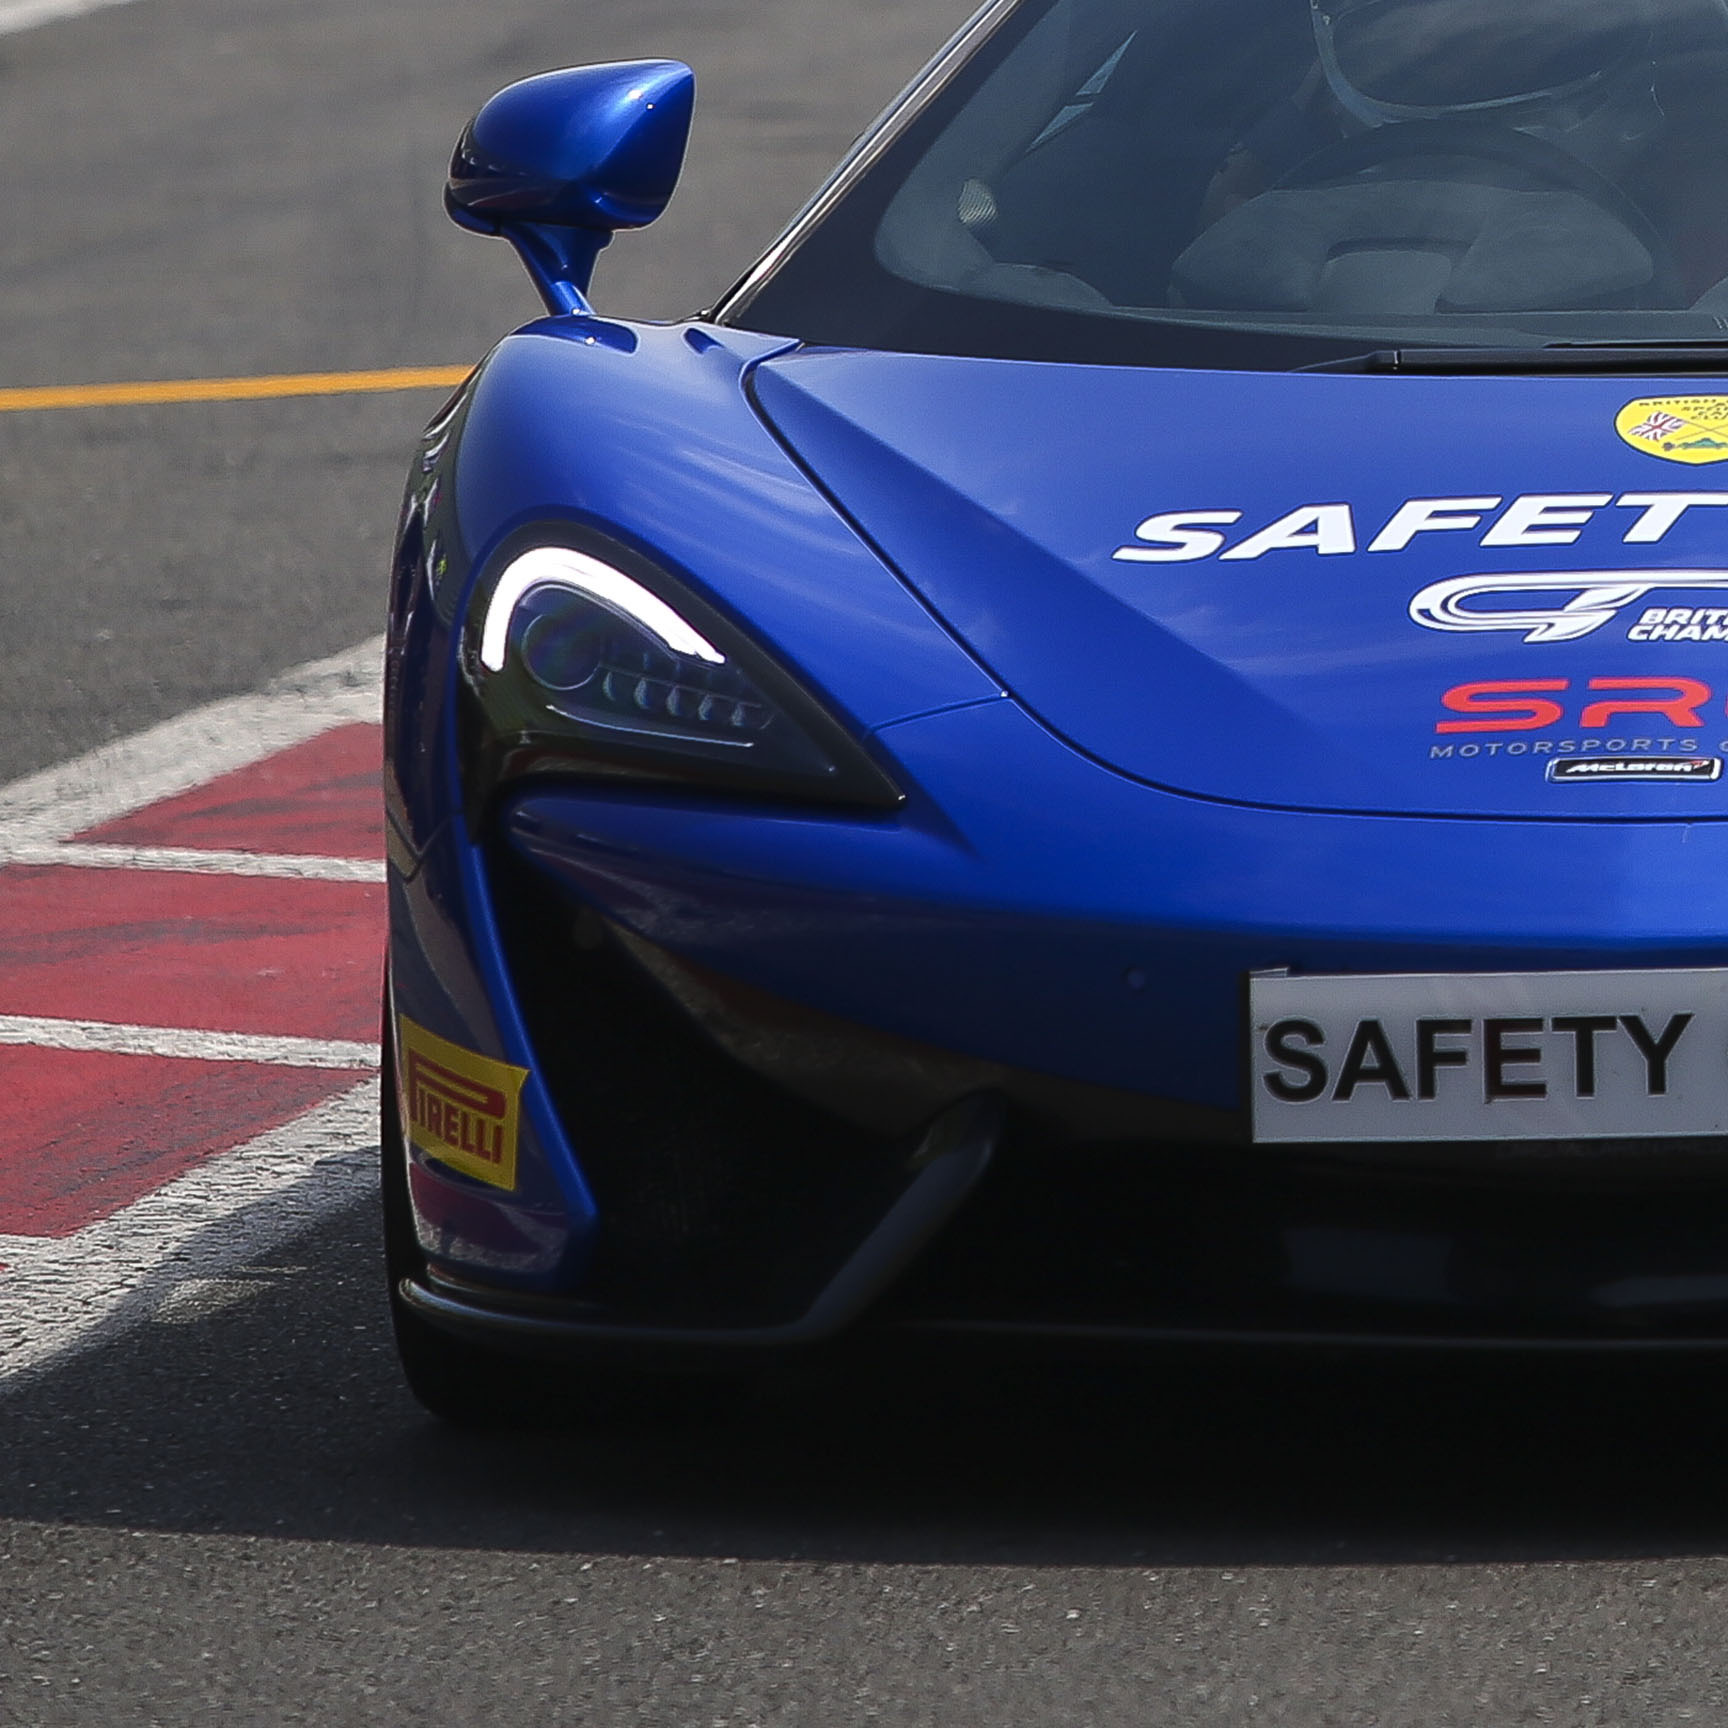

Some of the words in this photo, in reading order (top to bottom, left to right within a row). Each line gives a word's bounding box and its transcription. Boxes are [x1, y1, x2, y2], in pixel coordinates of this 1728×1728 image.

[1429, 736, 1699, 759] MOTORSPORTS
[1565, 759, 1695, 774] McLaren
[1261, 1011, 1695, 1104] SAFETY
[407, 1046, 508, 1165] PIRELLI
